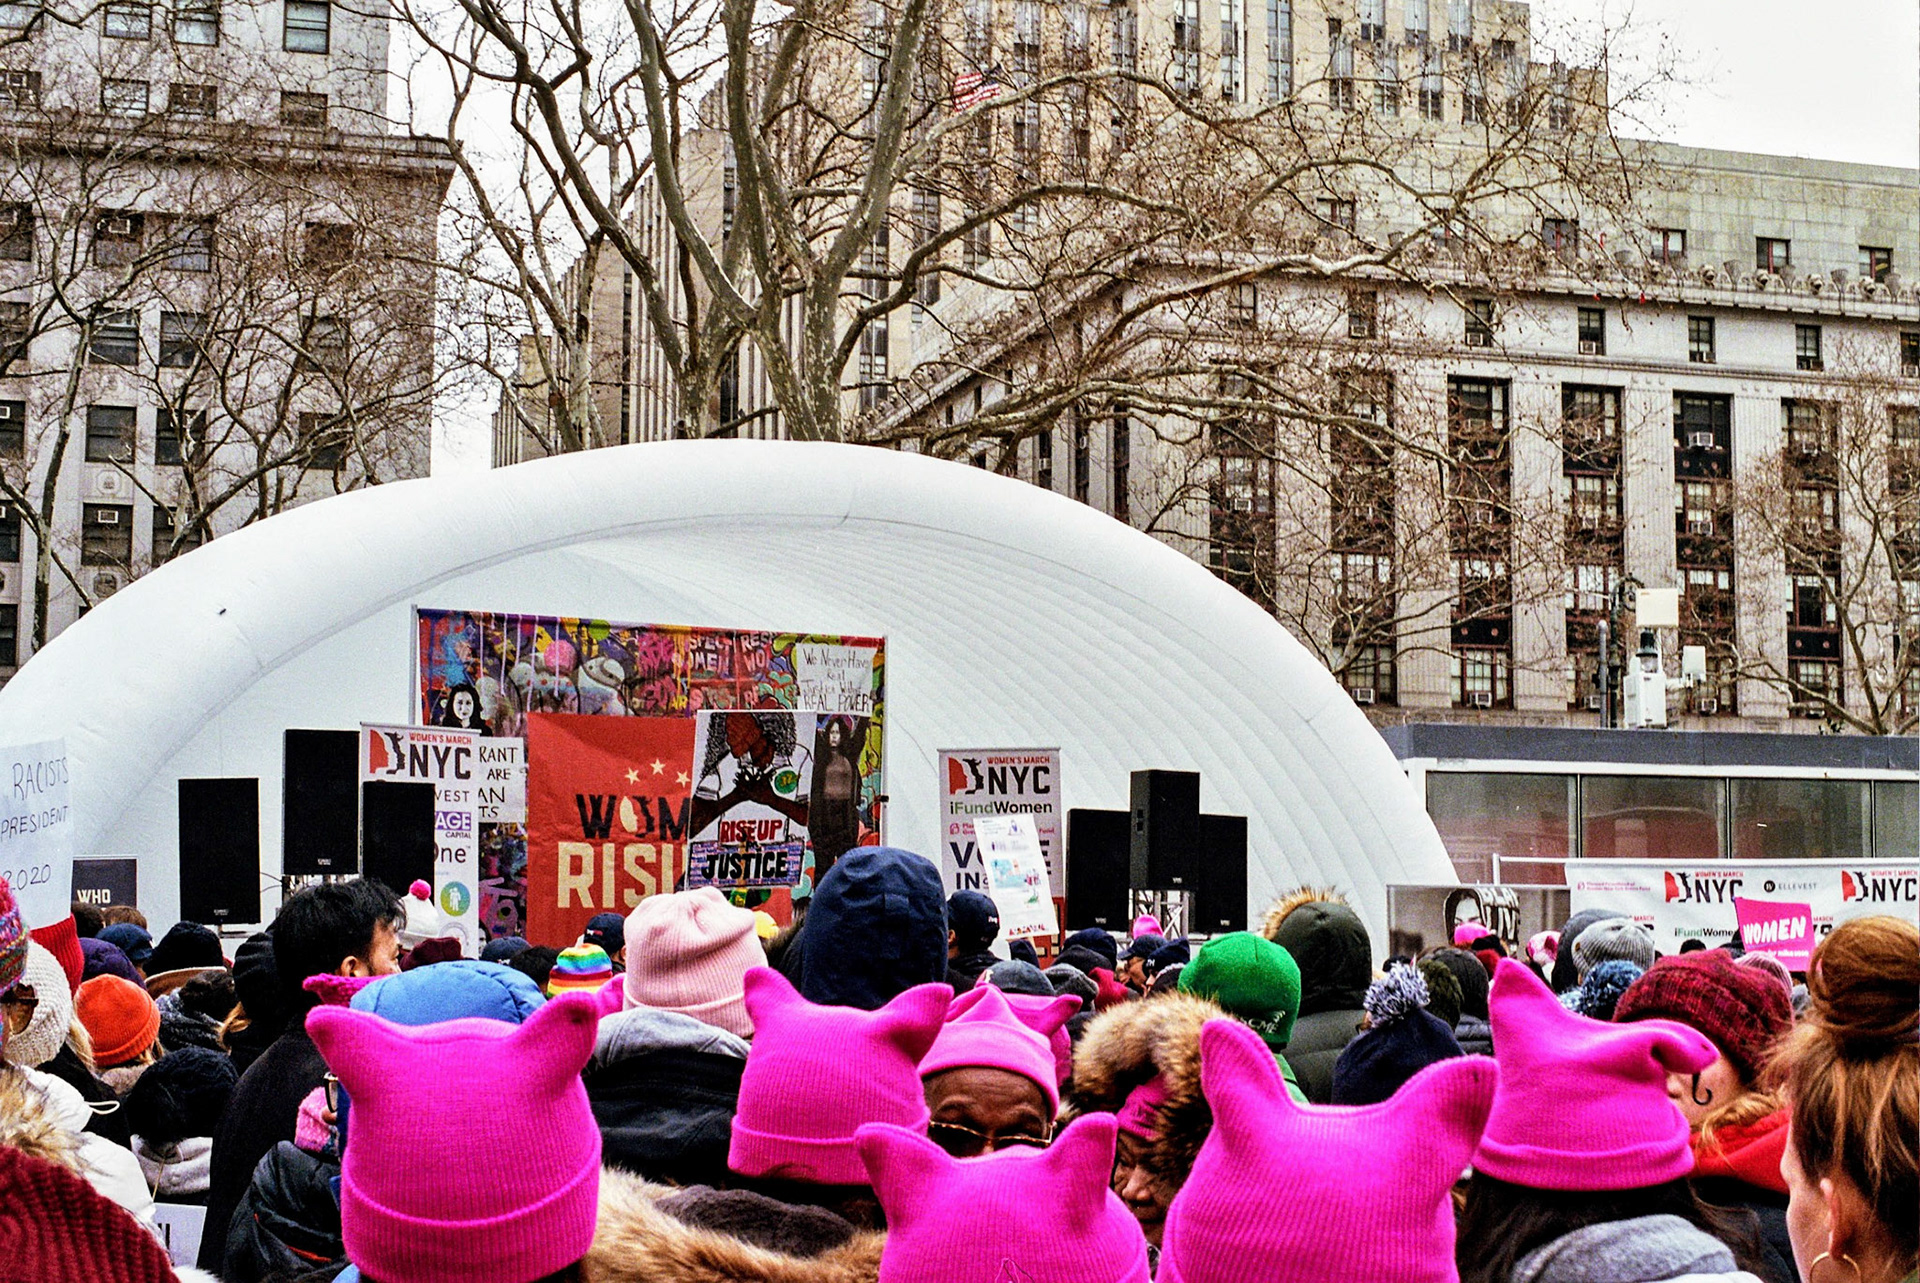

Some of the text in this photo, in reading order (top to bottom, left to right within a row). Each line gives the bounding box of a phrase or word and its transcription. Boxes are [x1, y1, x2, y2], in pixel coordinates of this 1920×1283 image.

[803, 690, 871, 713] REAL POWER
[409, 732, 472, 745] WOMEN'S MARCH
[409, 743, 472, 780] NYC
[987, 756, 1050, 765] WOMEN'S MARCH
[12, 756, 70, 801] RACISTS
[486, 768, 512, 782] ARE
[988, 766, 1051, 795] NYC
[949, 800, 1053, 814] iFundWomen
[0, 805, 69, 843] PRESIDENT
[445, 831, 472, 840] CAPITAL
[720, 819, 783, 843] RISE UP
[701, 851, 789, 880] JUSTICE
[956, 872, 980, 891] IN
[1695, 879, 1743, 903] NYC
[1778, 882, 1818, 891] ELLEVEST
[1872, 878, 1918, 902] NYC
[77, 889, 111, 904] WHO
[1674, 927, 1734, 937] iFundWome
[1743, 915, 1807, 945] WOMEN
